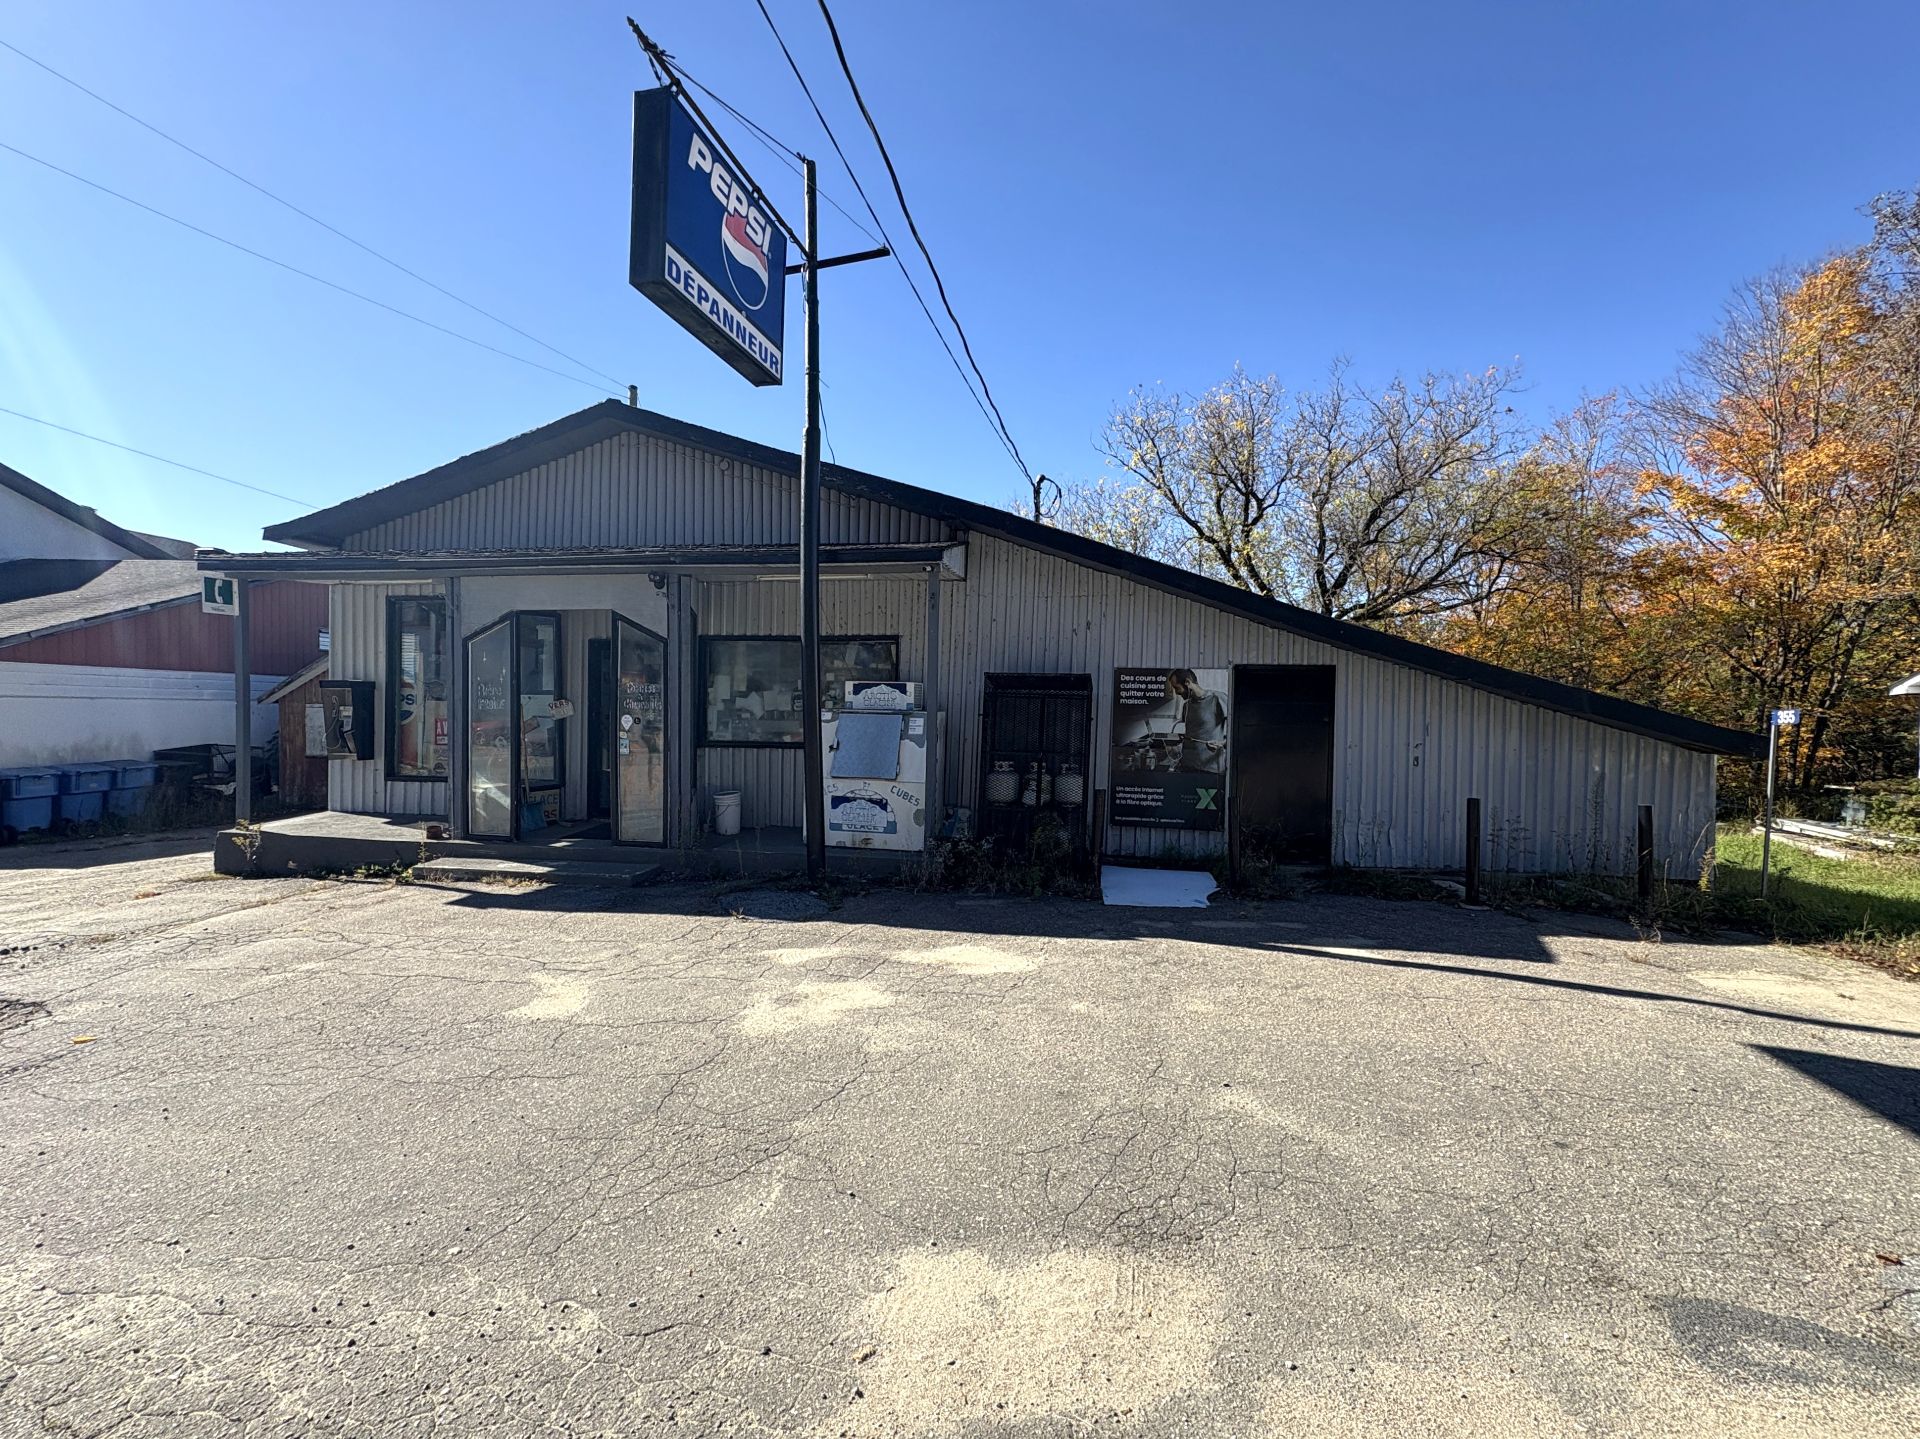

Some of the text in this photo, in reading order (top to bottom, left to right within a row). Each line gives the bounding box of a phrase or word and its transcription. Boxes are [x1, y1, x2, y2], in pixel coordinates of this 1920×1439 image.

[688, 132, 772, 255] PEPSI
[667, 255, 780, 375] DÉPANNEUR
[1120, 674, 1134, 682] Des
[1120, 690, 1144, 698] quitter
[548, 700, 569, 710] VERS
[1777, 710, 1796, 724] 355
[890, 785, 920, 807] CUBES
[1115, 792, 1164, 801] ultrarapide grâce
